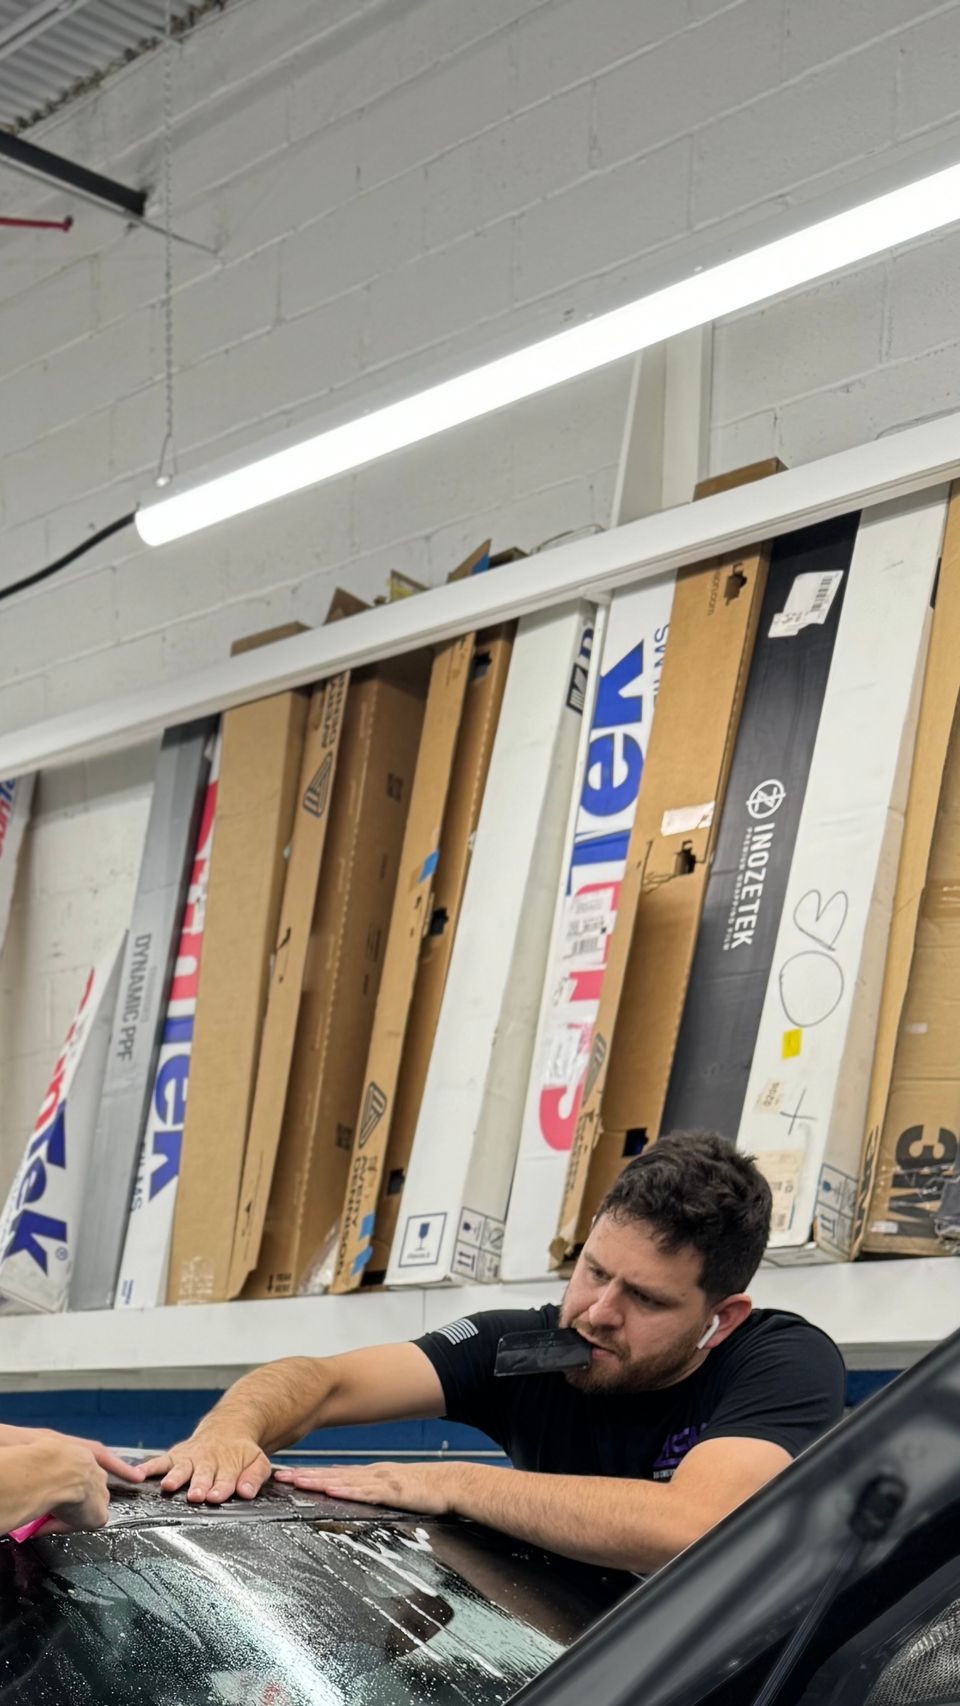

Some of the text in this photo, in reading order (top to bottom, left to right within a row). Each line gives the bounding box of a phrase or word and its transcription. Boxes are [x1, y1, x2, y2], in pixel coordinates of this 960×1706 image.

[538, 639, 644, 1151] STek
[731, 823, 776, 949] INOZETEK
[122, 933, 151, 1023] DYNAMIC
[117, 1025, 136, 1062] PPF
[2, 967, 95, 1277] nTek
